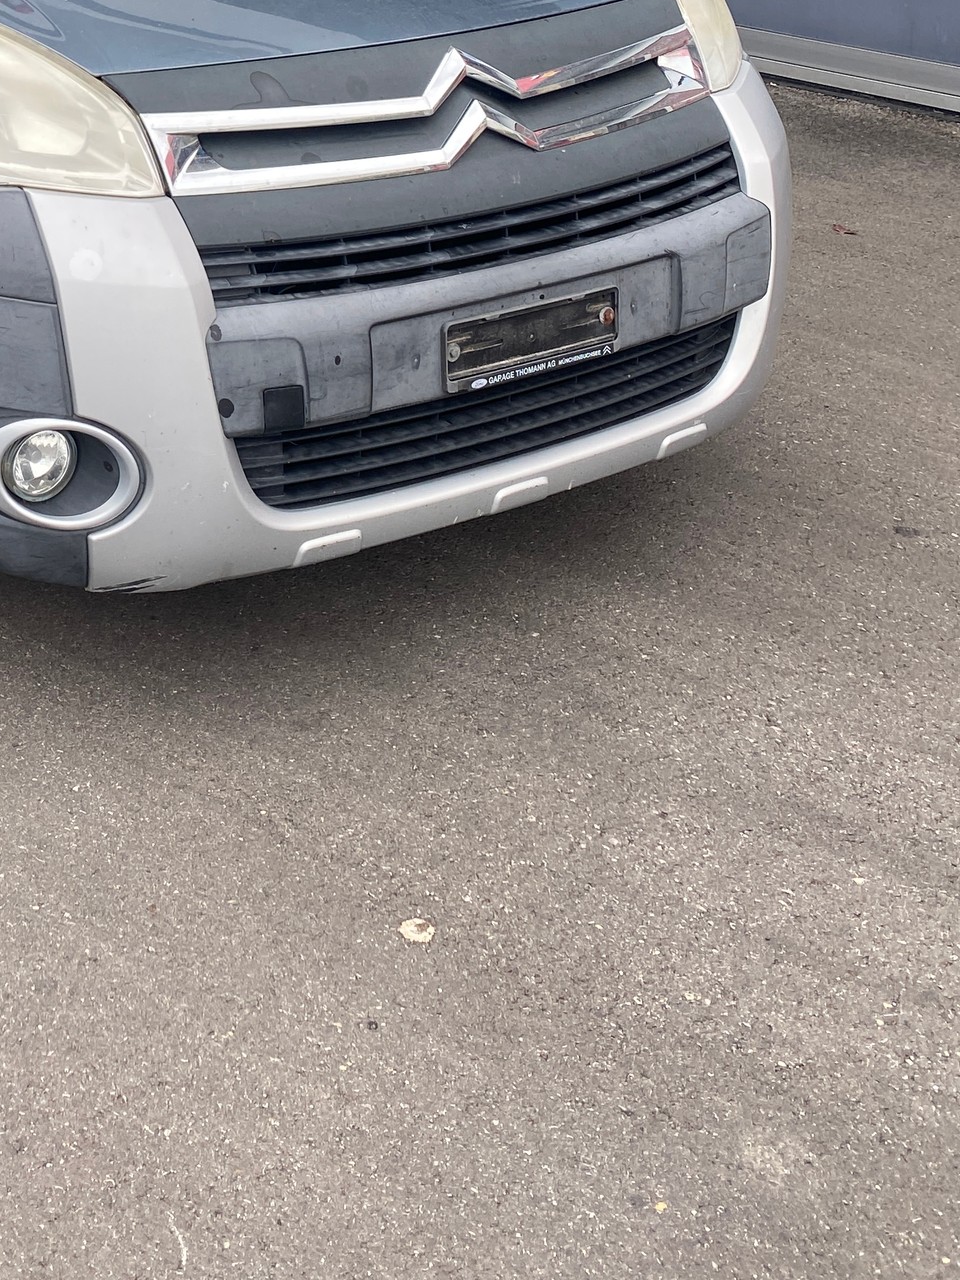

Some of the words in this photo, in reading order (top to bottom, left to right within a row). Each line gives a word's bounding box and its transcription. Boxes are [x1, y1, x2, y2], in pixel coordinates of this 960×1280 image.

[488, 371, 515, 384] GARAGE
[515, 361, 546, 377] THOMANN
[546, 359, 556, 370] AG
